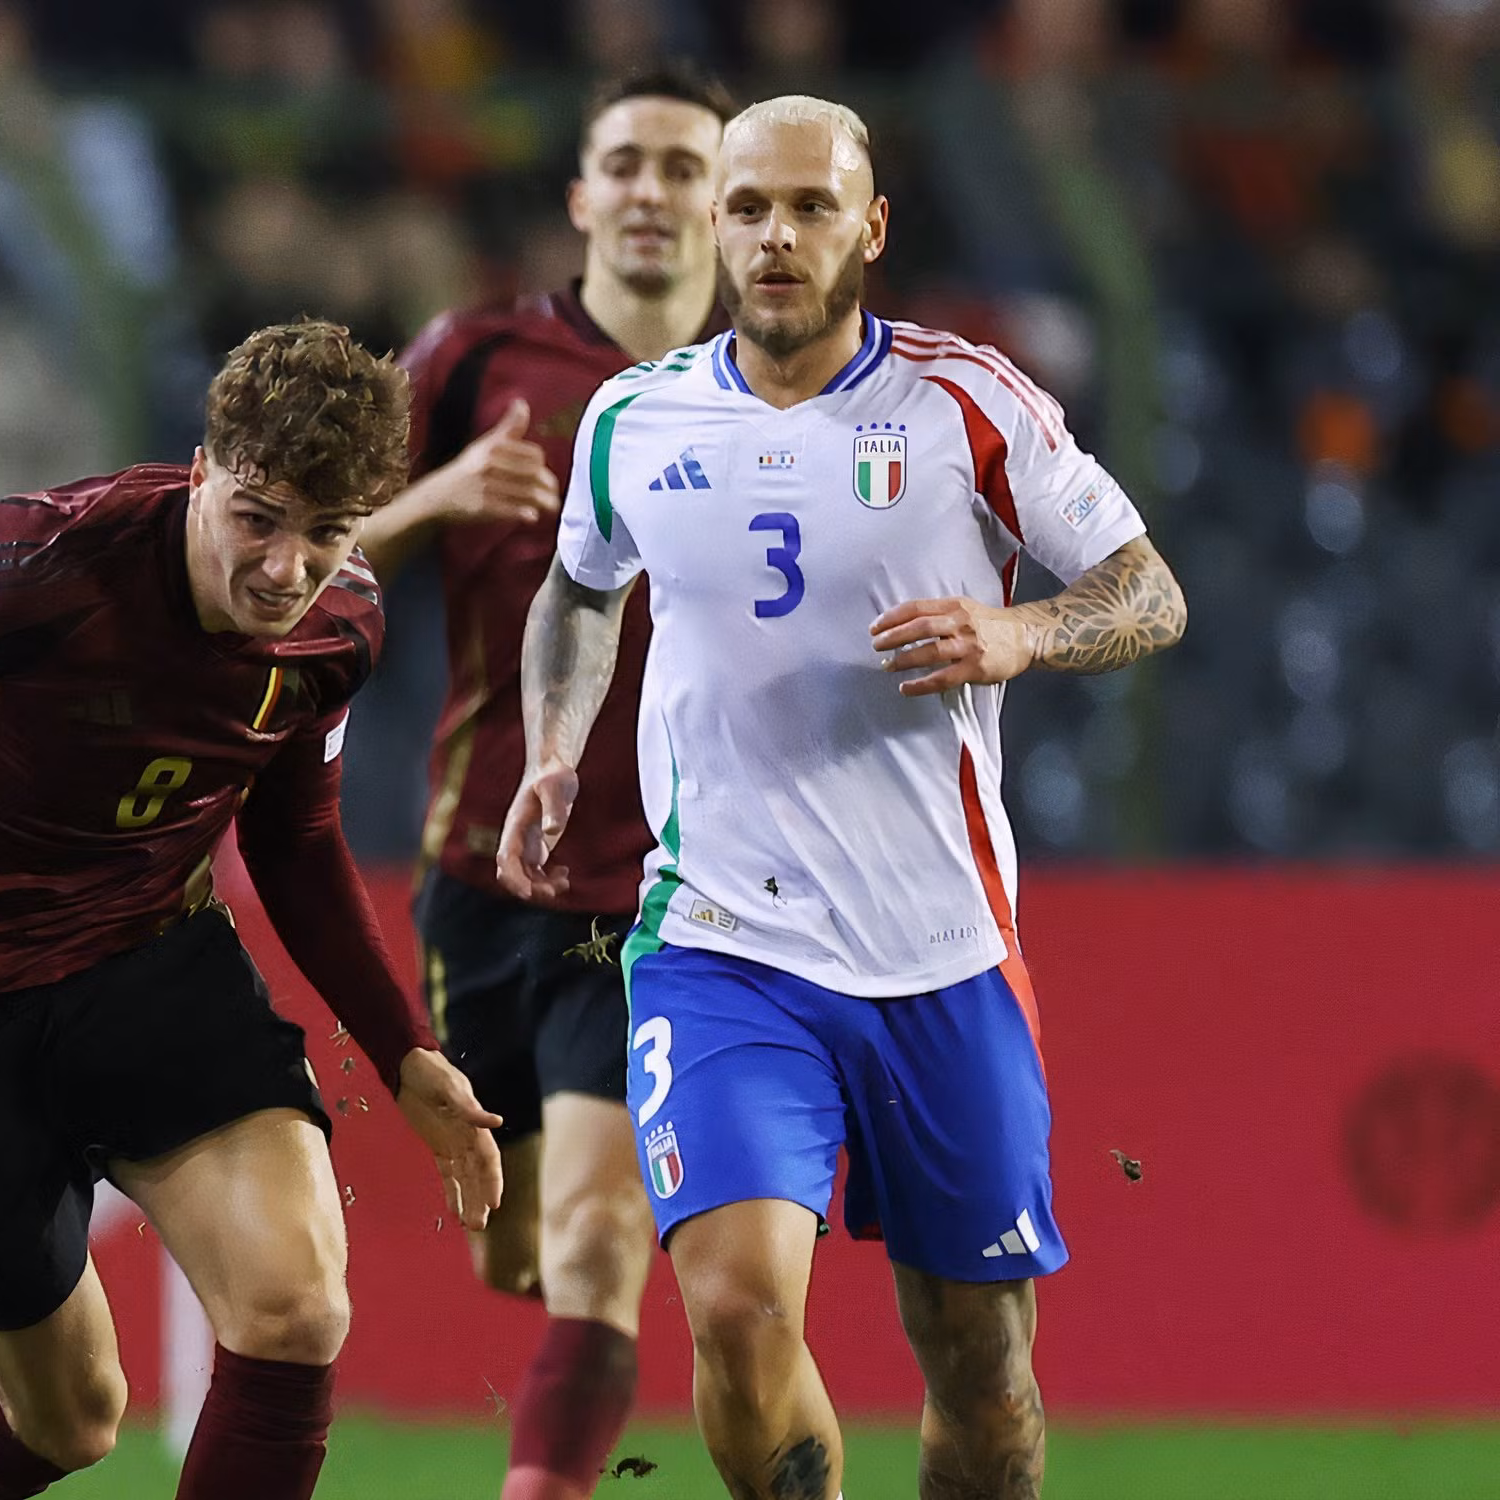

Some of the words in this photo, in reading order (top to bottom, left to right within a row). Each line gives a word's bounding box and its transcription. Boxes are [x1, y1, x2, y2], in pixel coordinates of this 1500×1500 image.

[858, 439, 902, 454] ITALIA
[748, 512, 805, 618] 3
[116, 756, 193, 828] 8
[632, 1015, 673, 1129] 3
